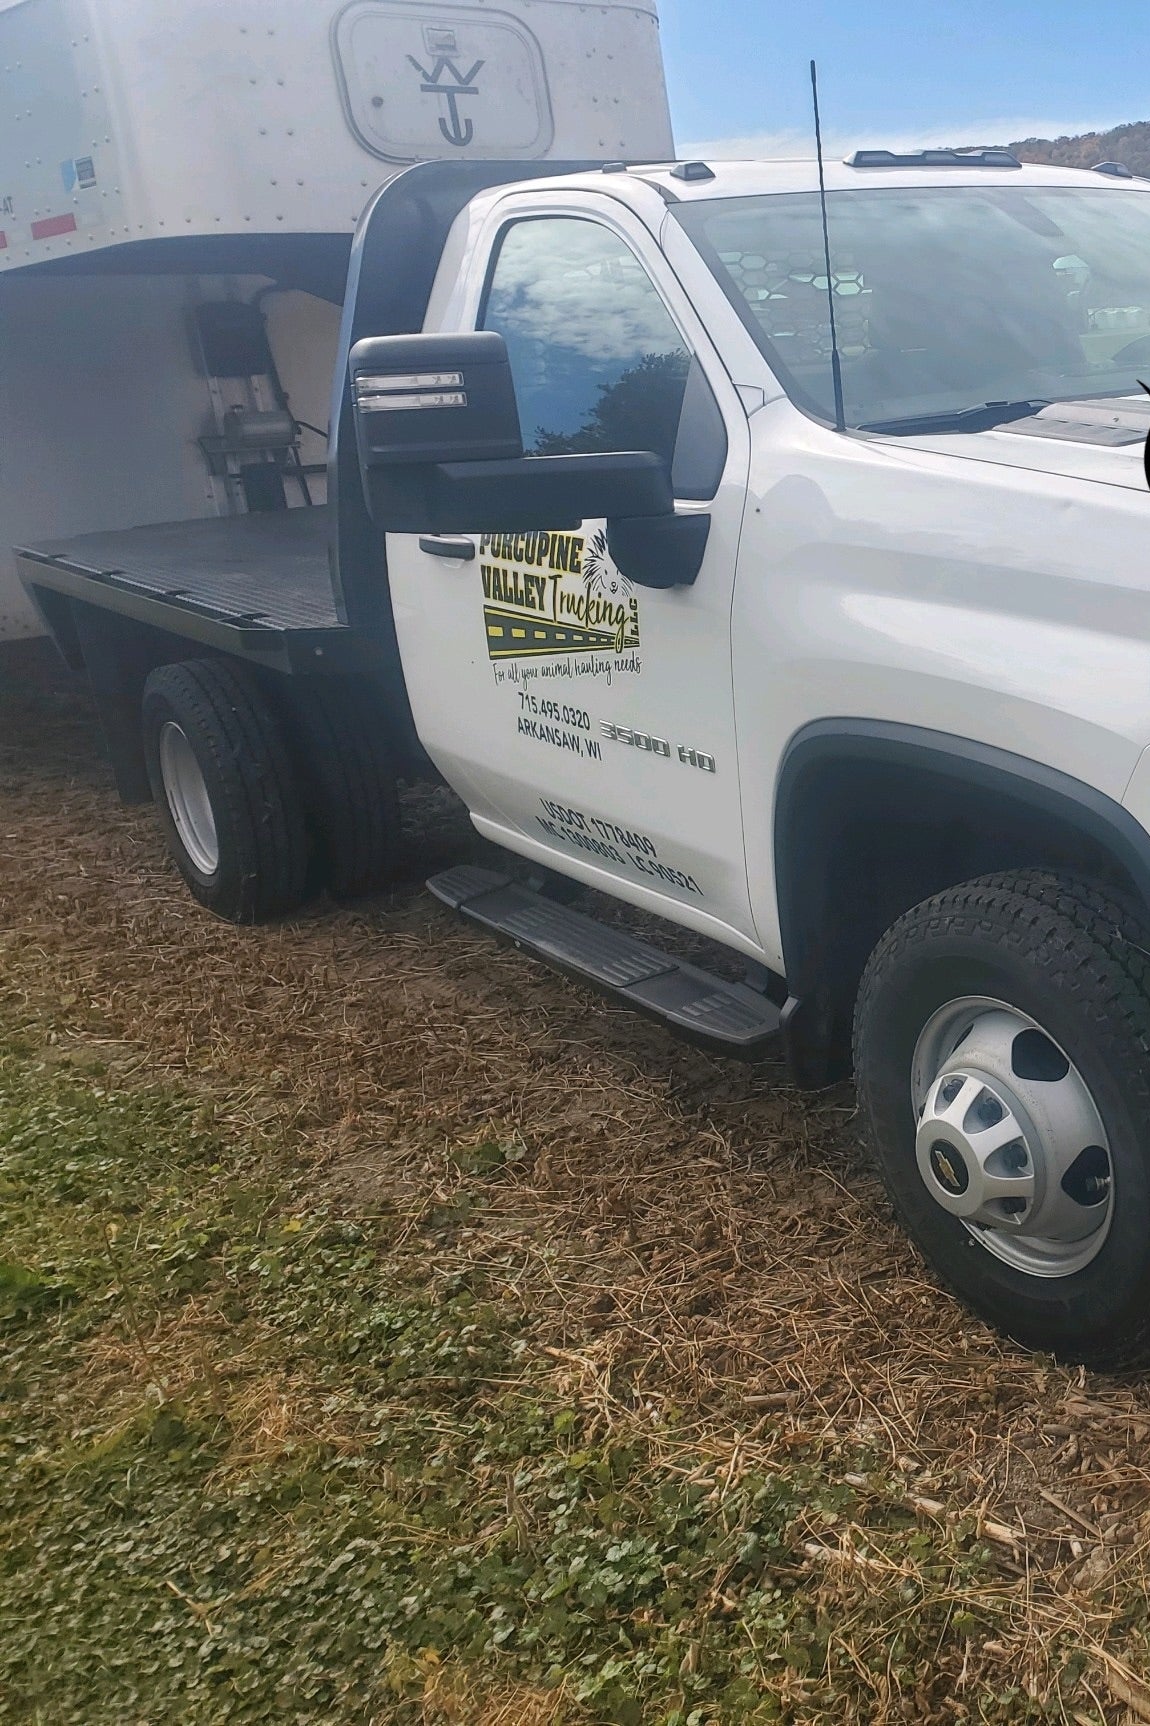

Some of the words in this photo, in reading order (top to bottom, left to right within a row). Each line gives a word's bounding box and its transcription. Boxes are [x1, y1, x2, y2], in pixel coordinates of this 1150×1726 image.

[480, 531, 584, 574] PORCUPINE
[481, 565, 546, 611] VALLEY
[549, 574, 630, 653] Trucking
[629, 598, 638, 637] LLC
[493, 662, 505, 685] For
[508, 663, 519, 683] all
[521, 667, 538, 690] your
[541, 658, 572, 678] animal
[574, 655, 612, 685] hauling
[615, 651, 642, 674] needs
[518, 692, 590, 730] 715.495.0320
[518, 716, 583, 757] ARKANSAW,
[585, 738, 602, 760] WI
[600, 719, 670, 757] 3500
[677, 744, 716, 773] HD
[539, 798, 591, 833] USDOT
[591, 818, 657, 858] 1778409
[535, 816, 565, 840] MC
[627, 852, 654, 875] LC
[648, 860, 704, 896] 90521
